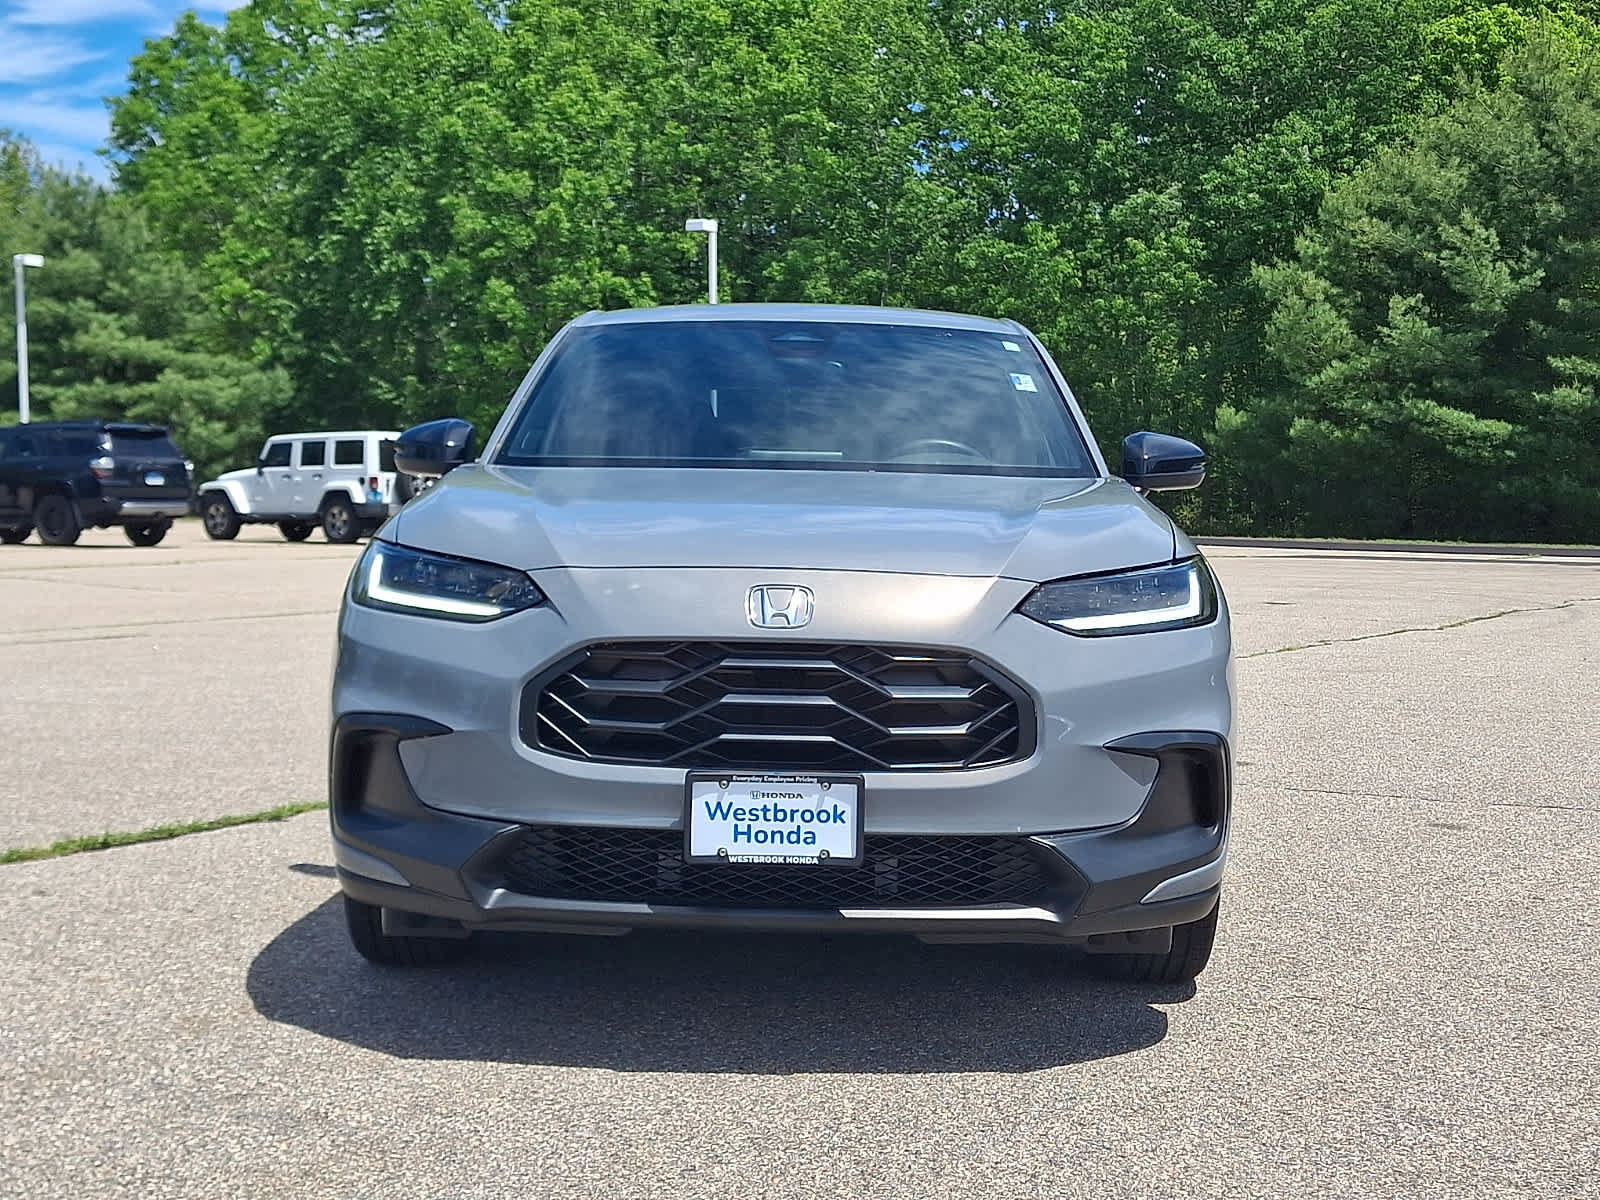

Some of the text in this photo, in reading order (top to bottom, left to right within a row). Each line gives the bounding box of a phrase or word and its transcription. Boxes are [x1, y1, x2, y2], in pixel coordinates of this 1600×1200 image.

[732, 775, 762, 783] Everyday
[796, 776, 818, 784] Pricing
[761, 791, 804, 799] HONDA
[704, 800, 846, 824] Westbrook
[733, 823, 817, 845] Honda
[728, 855, 819, 865] WESTBROOK HONDA
